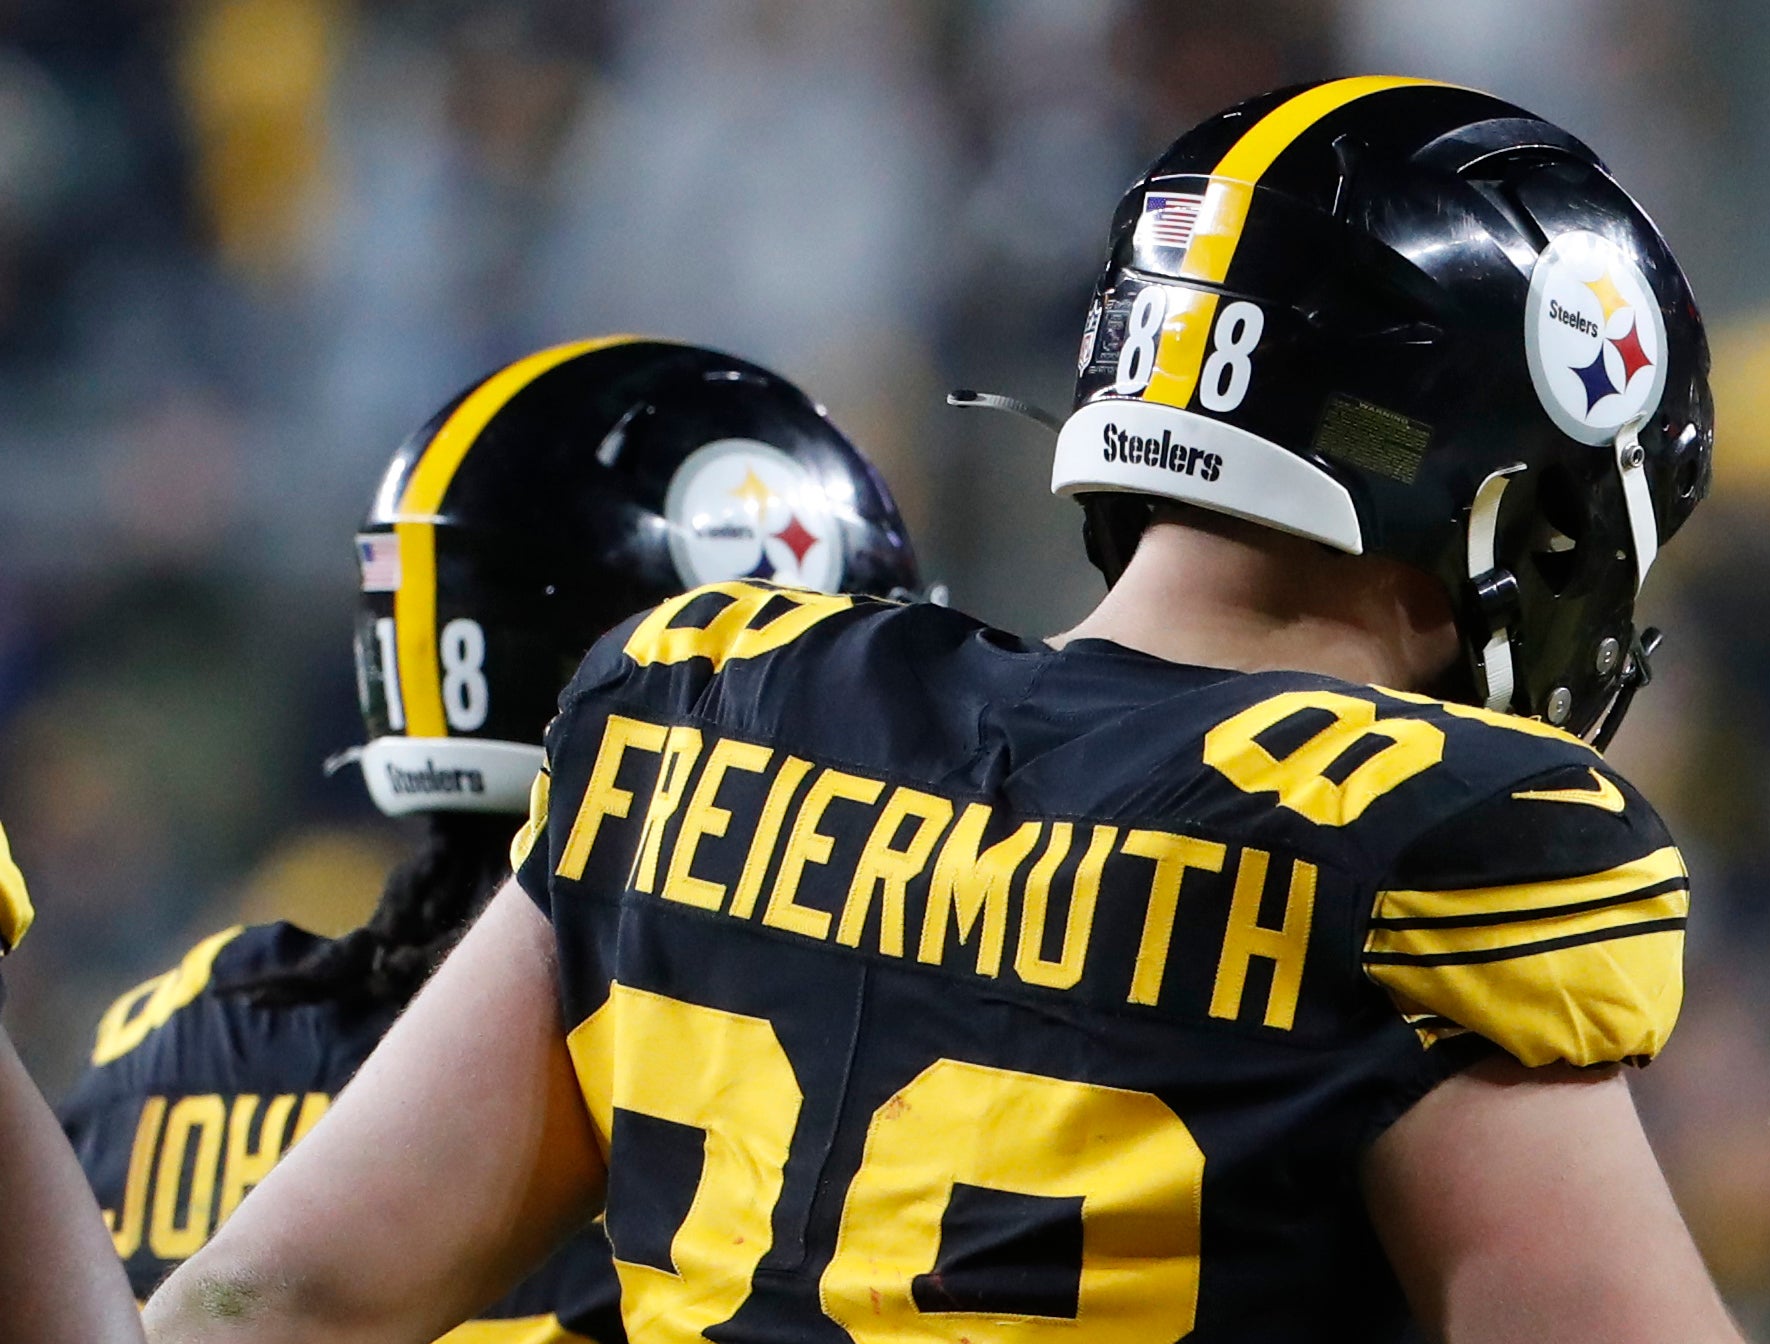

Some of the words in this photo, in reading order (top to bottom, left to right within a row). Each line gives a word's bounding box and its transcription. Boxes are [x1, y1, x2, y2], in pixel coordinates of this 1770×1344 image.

[1116, 285, 1265, 413] 88
[1549, 299, 1599, 338] Steelers
[1103, 422, 1224, 483] Steelers
[375, 607, 489, 732] 18
[556, 714, 1318, 1031] FREIERMUTH
